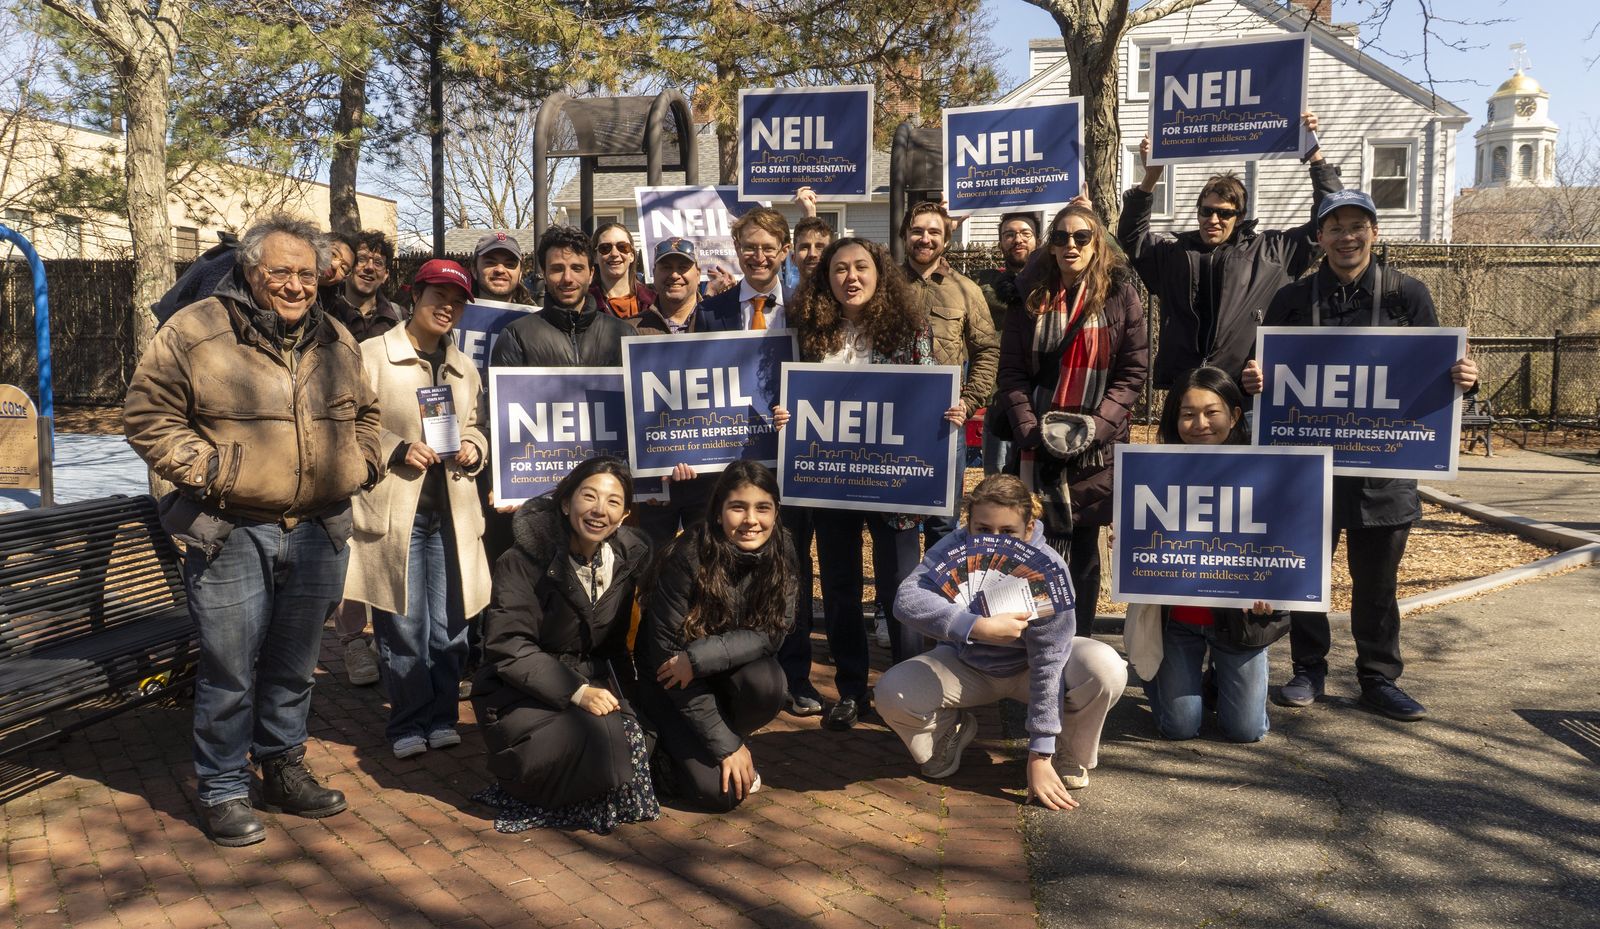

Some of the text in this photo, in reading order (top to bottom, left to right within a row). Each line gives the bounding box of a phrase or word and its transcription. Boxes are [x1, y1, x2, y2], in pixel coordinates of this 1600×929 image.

[1163, 69, 1261, 111] NEIL
[751, 116, 833, 151] NEIL
[1162, 119, 1288, 136] FOR STATE REPRESENTATIVE
[1162, 137, 1195, 146] democrat
[1197, 135, 1209, 144] for
[1210, 132, 1247, 143] middlesex
[956, 129, 1043, 167] NEIL
[751, 164, 857, 174] FOR STATE REPRESENTATIVE
[751, 175, 780, 183] democrat
[781, 175, 791, 183] for
[792, 175, 823, 183] middlesex
[956, 173, 1069, 189] FOR STATE REPRESENTATIVE
[956, 191, 987, 199] democrat
[988, 188, 999, 196] for
[1000, 186, 1033, 196] middlesex
[651, 208, 732, 238] NEIL
[641, 366, 753, 412] NEIL
[1272, 364, 1400, 410] NEIL
[508, 401, 618, 443] NEIL
[795, 399, 905, 446] NEIL
[646, 424, 778, 441] FOR STATE REPRESENTATIV
[1271, 425, 1436, 441] FOR STATE REPRESENTATIVE
[646, 443, 685, 453] democrat
[687, 441, 700, 450] for
[702, 438, 743, 449] middlesex
[1333, 441, 1381, 452] middlesex
[1384, 442, 1403, 453] 26th
[510, 462, 532, 472] FOR
[535, 461, 563, 471] STATE
[794, 460, 935, 477] FOR STATE REPRESENTATIVE
[511, 474, 550, 484] democrat
[793, 473, 907, 488] democrat for middlesex 26th
[1133, 484, 1267, 534] NEIL
[1132, 552, 1306, 569] FOR STATE REPRESENTATIVE
[1132, 567, 1273, 582] democrat for middlesex 26th
